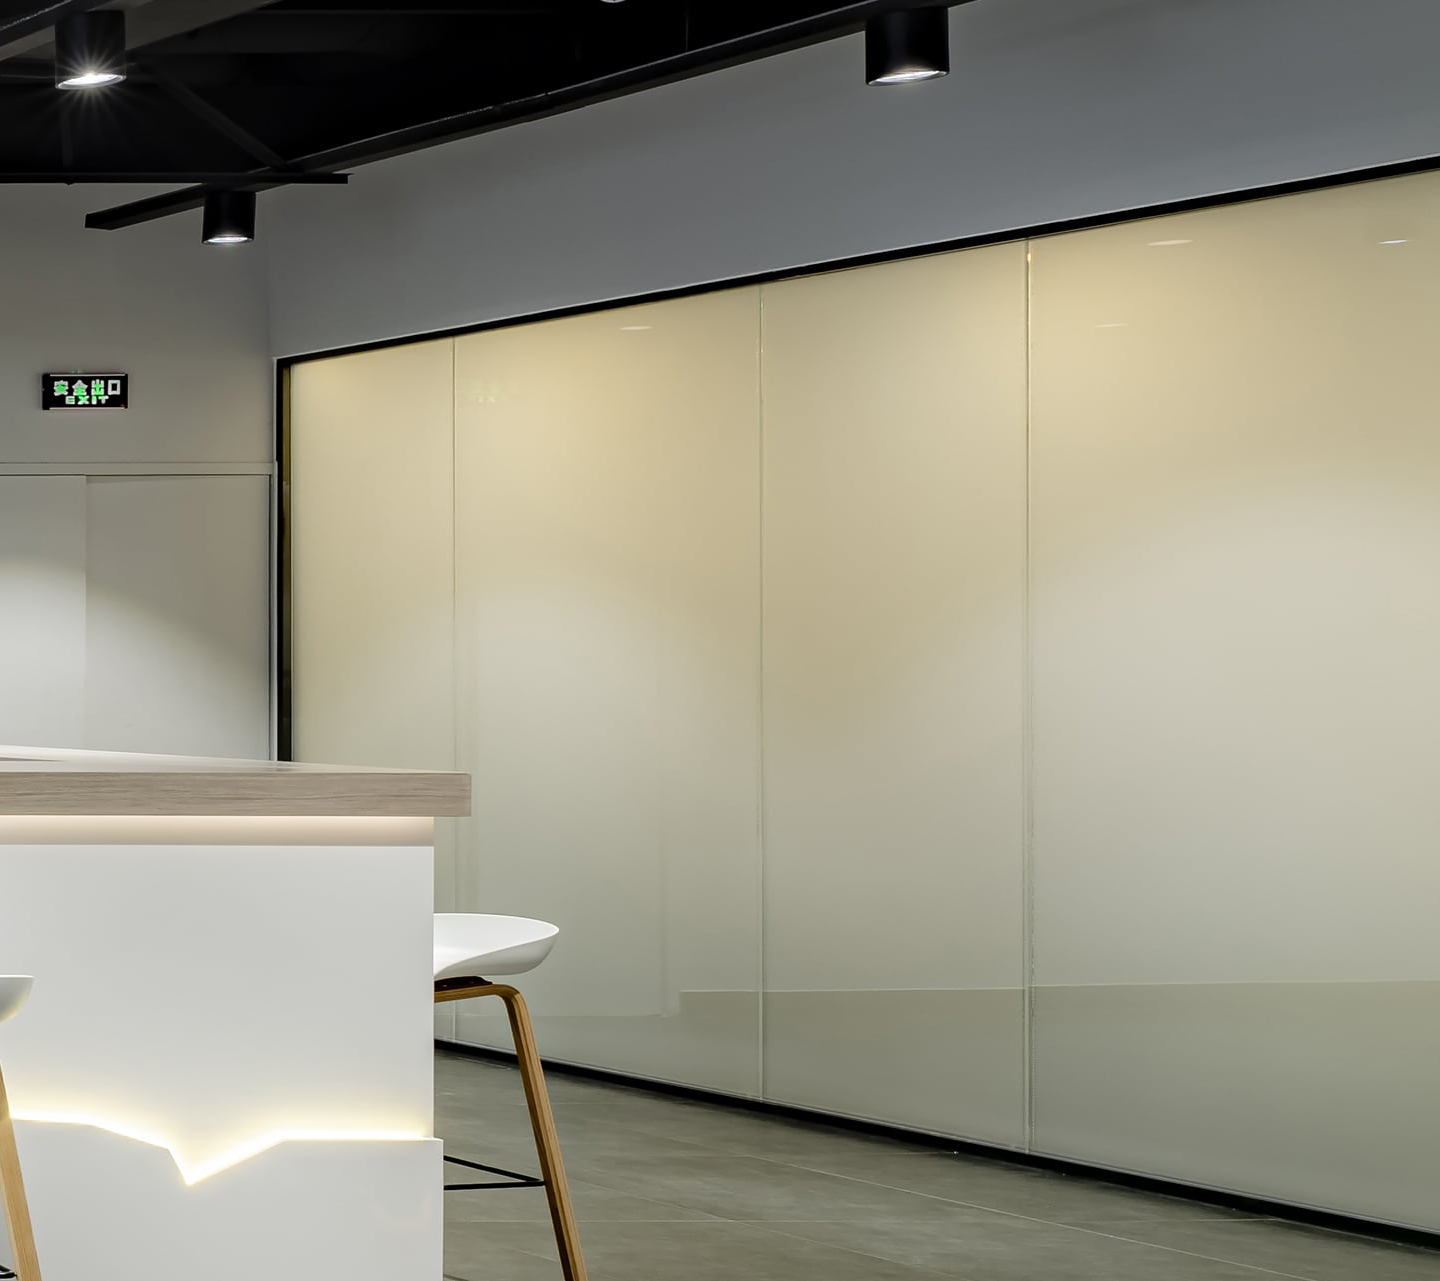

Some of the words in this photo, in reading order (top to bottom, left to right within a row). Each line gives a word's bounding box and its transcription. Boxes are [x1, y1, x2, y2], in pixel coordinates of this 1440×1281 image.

[53, 379, 121, 396] 安全出口
[65, 395, 109, 405] EXIT
